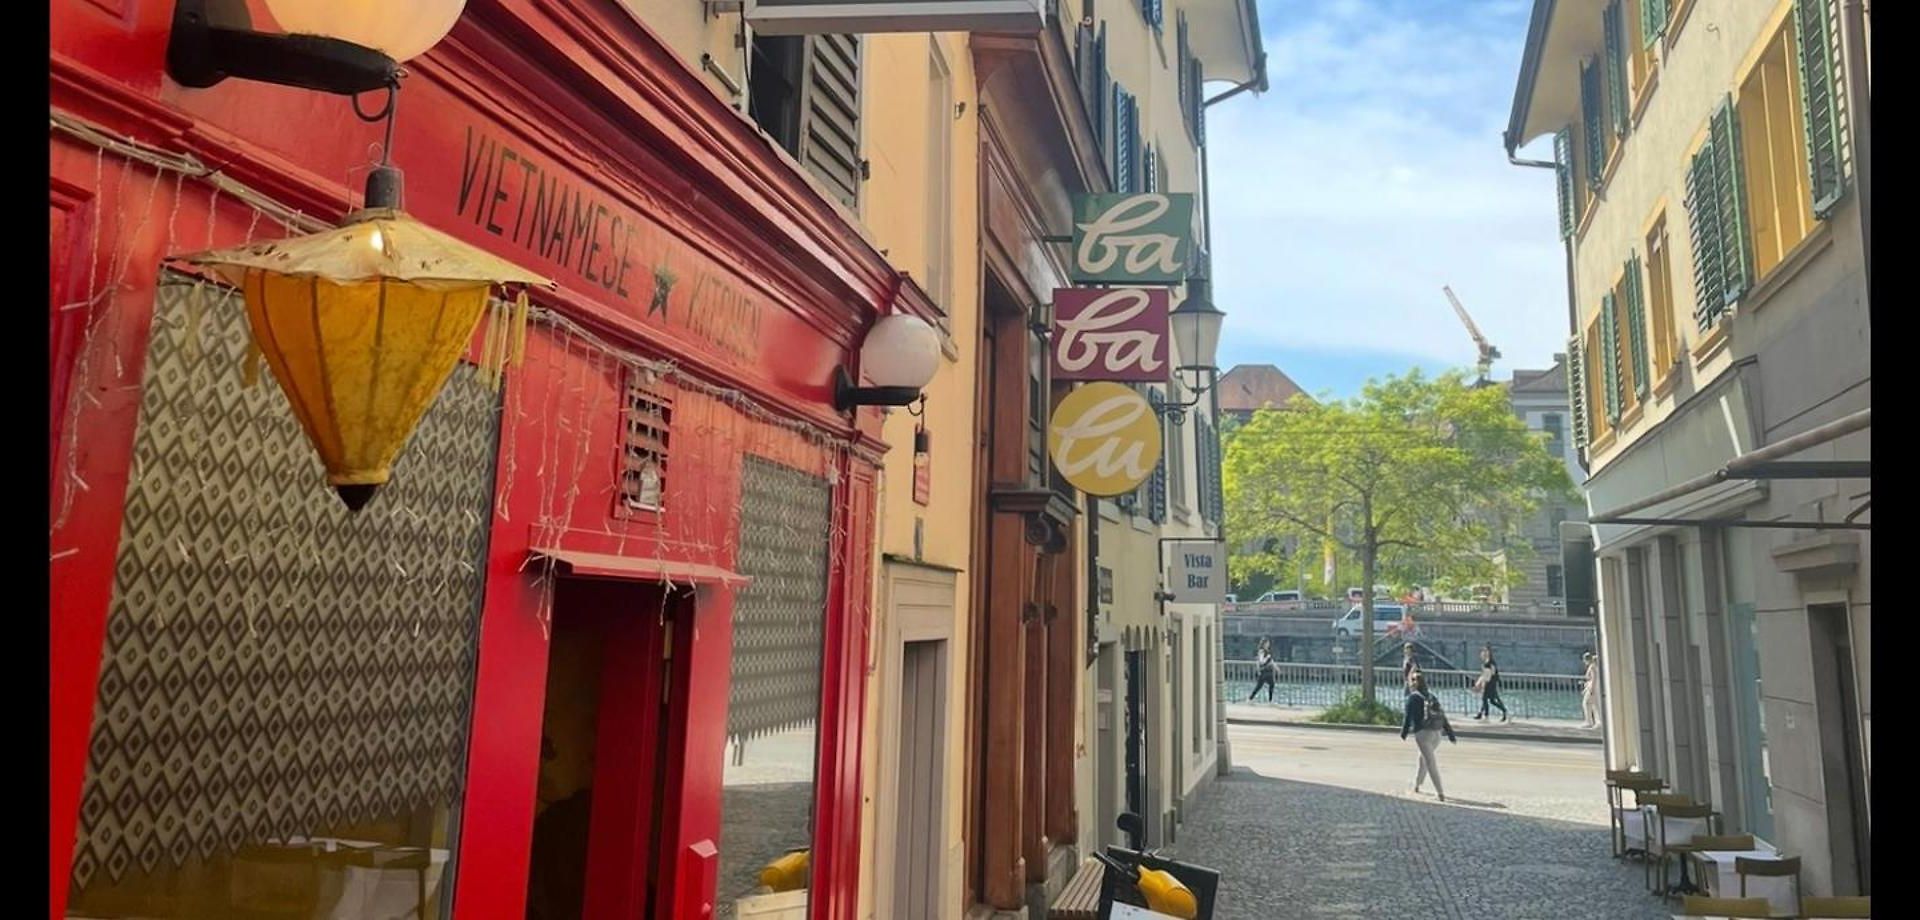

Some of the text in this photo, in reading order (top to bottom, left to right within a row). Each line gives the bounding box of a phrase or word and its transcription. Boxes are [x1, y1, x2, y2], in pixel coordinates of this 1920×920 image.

[457, 125, 638, 298] VIETNAMESE
[1075, 193, 1184, 275] ba
[1056, 288, 1164, 373] ba
[1184, 553, 1213, 568] Vista
[1187, 574, 1209, 589] Bar
